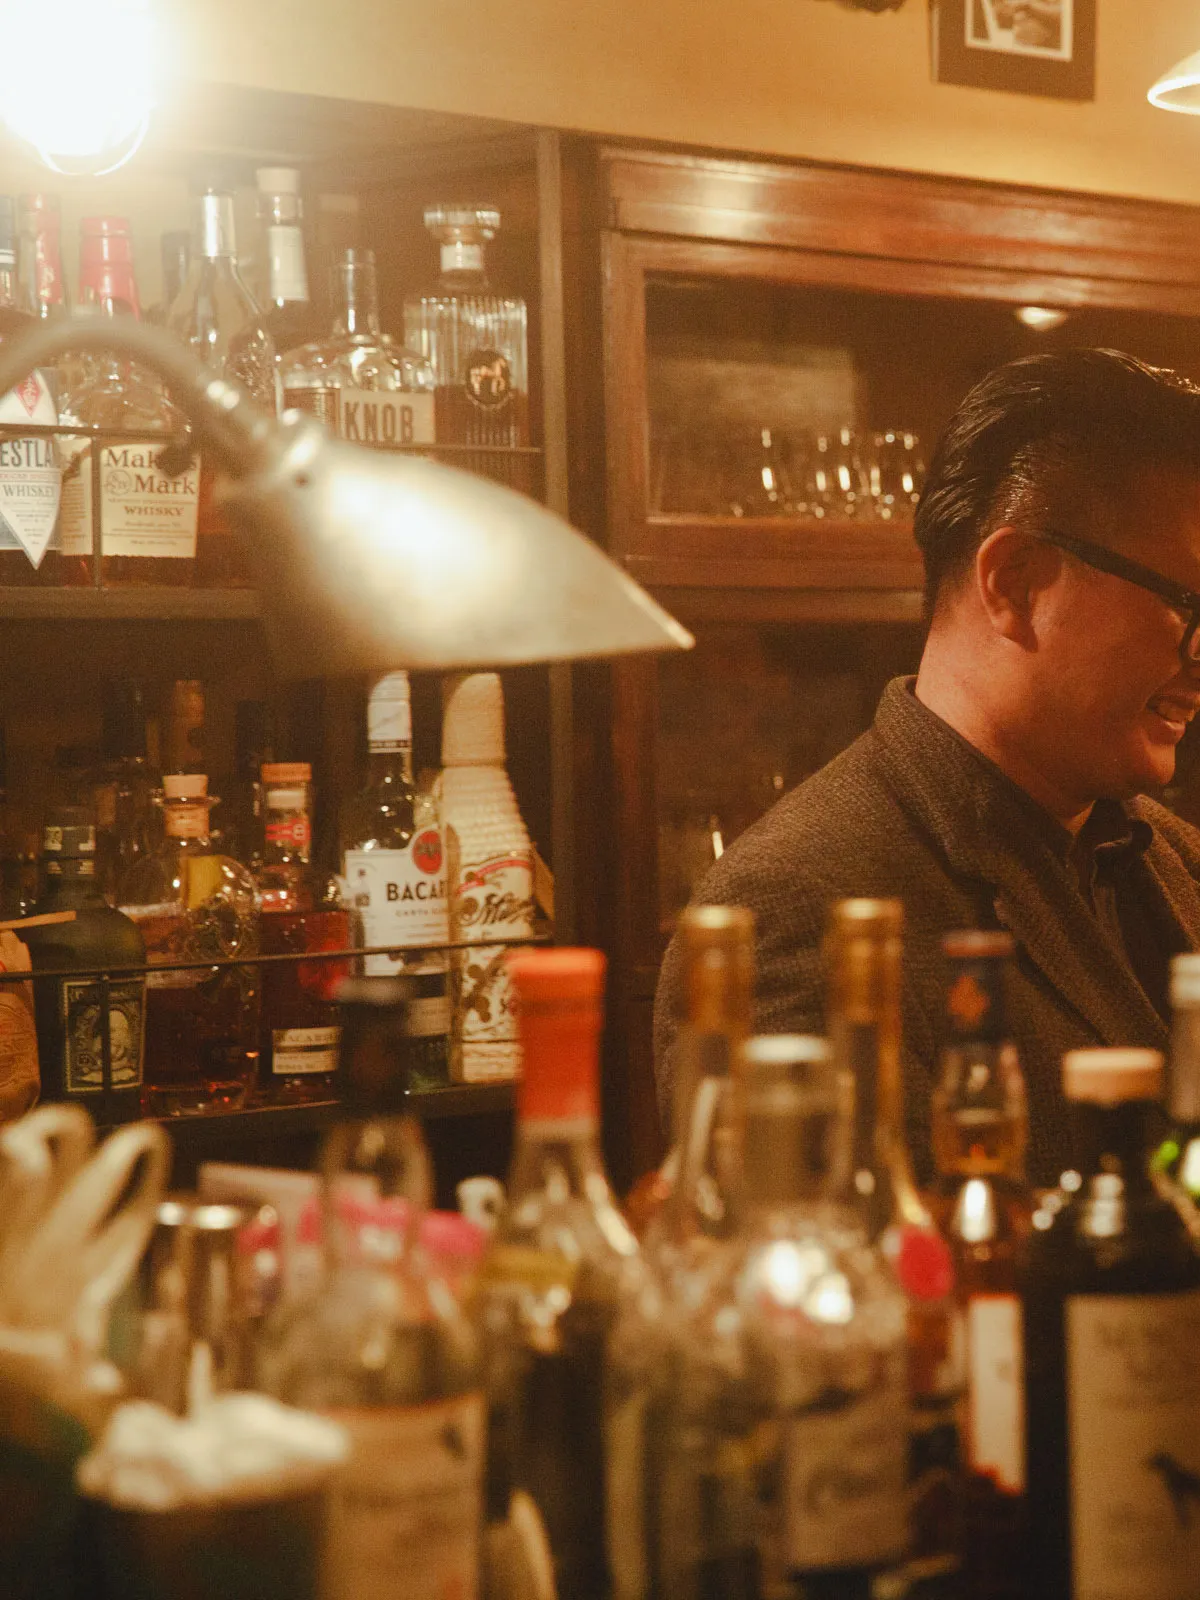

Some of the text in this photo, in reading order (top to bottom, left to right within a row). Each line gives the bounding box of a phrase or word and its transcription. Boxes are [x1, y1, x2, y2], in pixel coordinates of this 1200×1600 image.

[344, 401, 414, 443] KNOB
[3, 484, 55, 497] WHISKE
[133, 473, 196, 495] Mark
[124, 505, 185, 517] WHISKY
